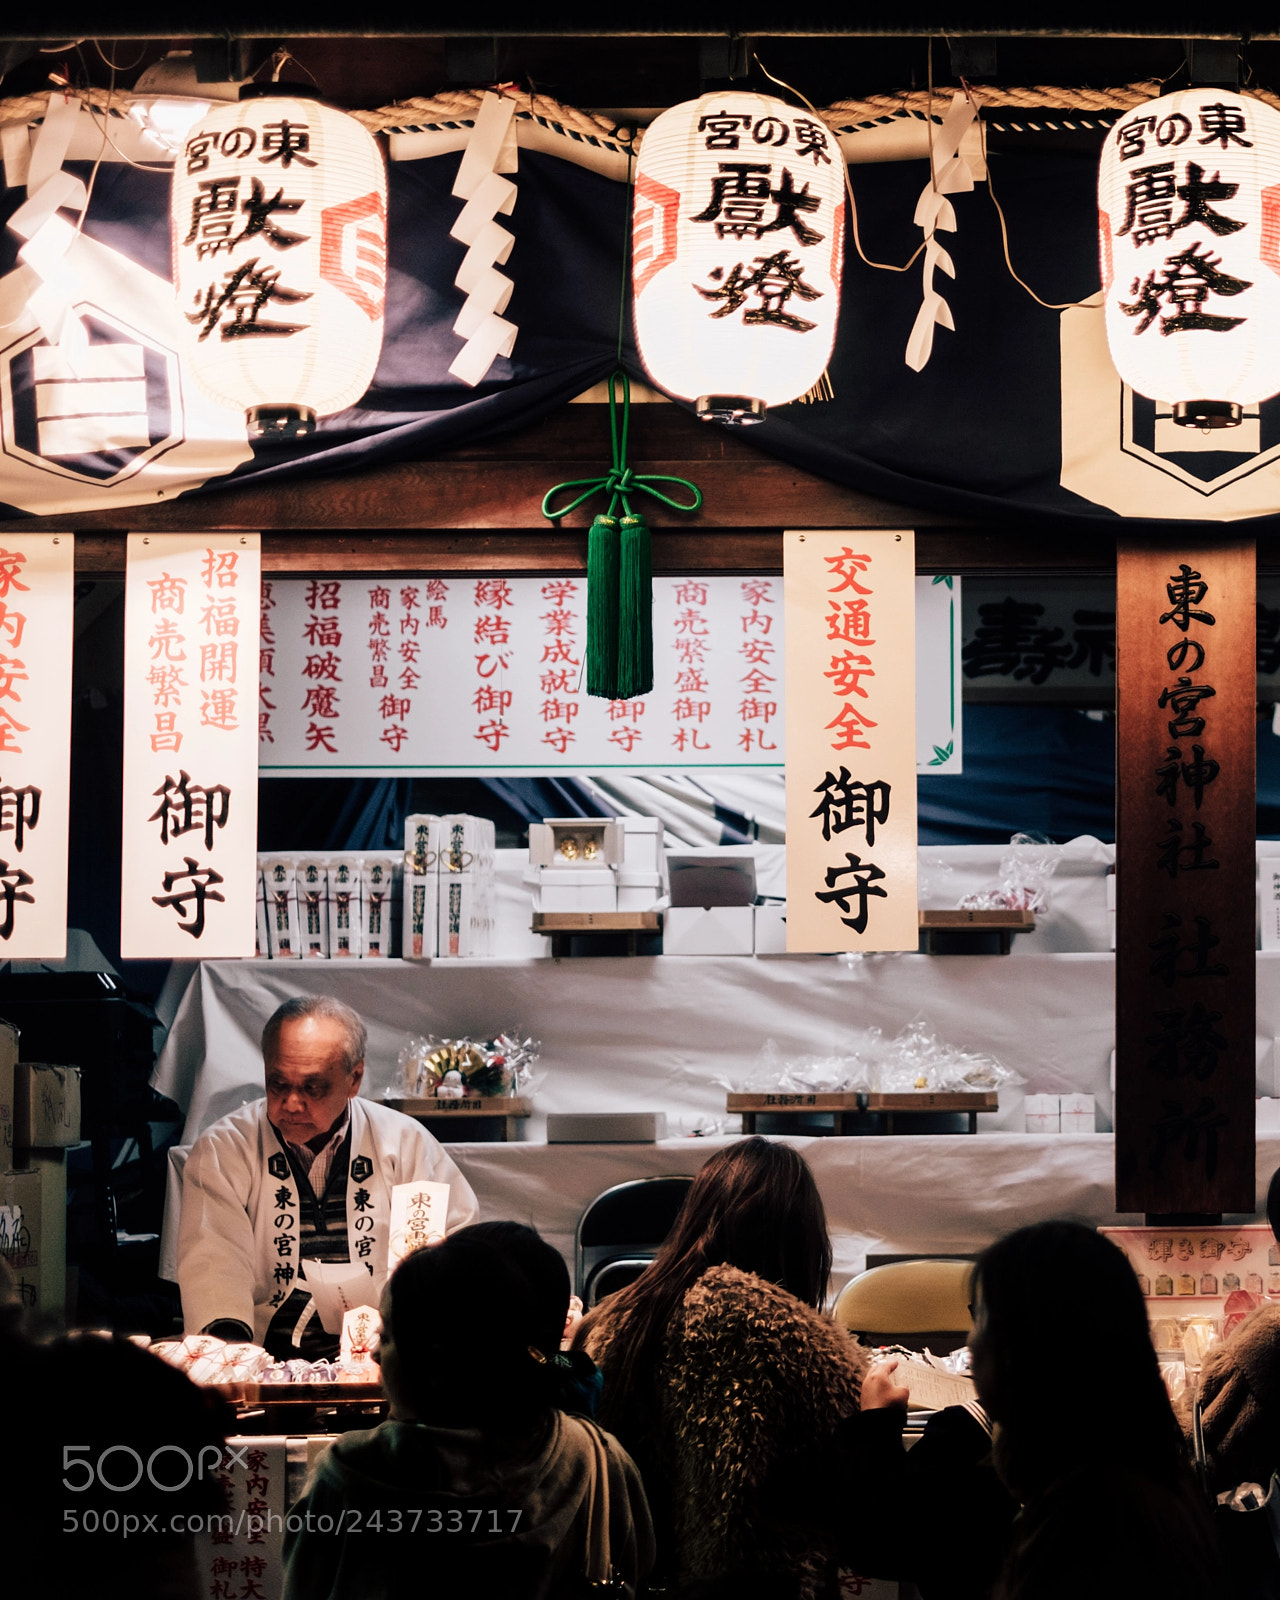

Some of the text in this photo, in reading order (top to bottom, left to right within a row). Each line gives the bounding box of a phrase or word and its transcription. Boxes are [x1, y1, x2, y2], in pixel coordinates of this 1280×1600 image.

[185, 119, 319, 176] 東の宮
[698, 110, 831, 166] 東の宮
[1116, 102, 1254, 162] 東の宮
[145, 571, 189, 753] 商売繁昌
[199, 547, 240, 731] 招福開運
[301, 581, 343, 753] 招福破魔矢
[367, 585, 391, 688] 商売繁昌
[399, 585, 421, 690] 家内安全
[425, 579, 449, 629] 絵馬
[472, 578, 514, 753] 縁結び御守
[540, 580, 580, 754] 学業成就御守
[672, 580, 712, 753] 商売繁盛御札
[738, 579, 778, 753] 家内安全御札
[823, 547, 878, 751] 交通安全
[378, 693, 412, 752] 御守
[1157, 564, 1220, 879] 東の宮神社
[147, 769, 232, 939] 御守
[808, 765, 892, 935] 御守
[354, 1187, 375, 1277] 東の宮
